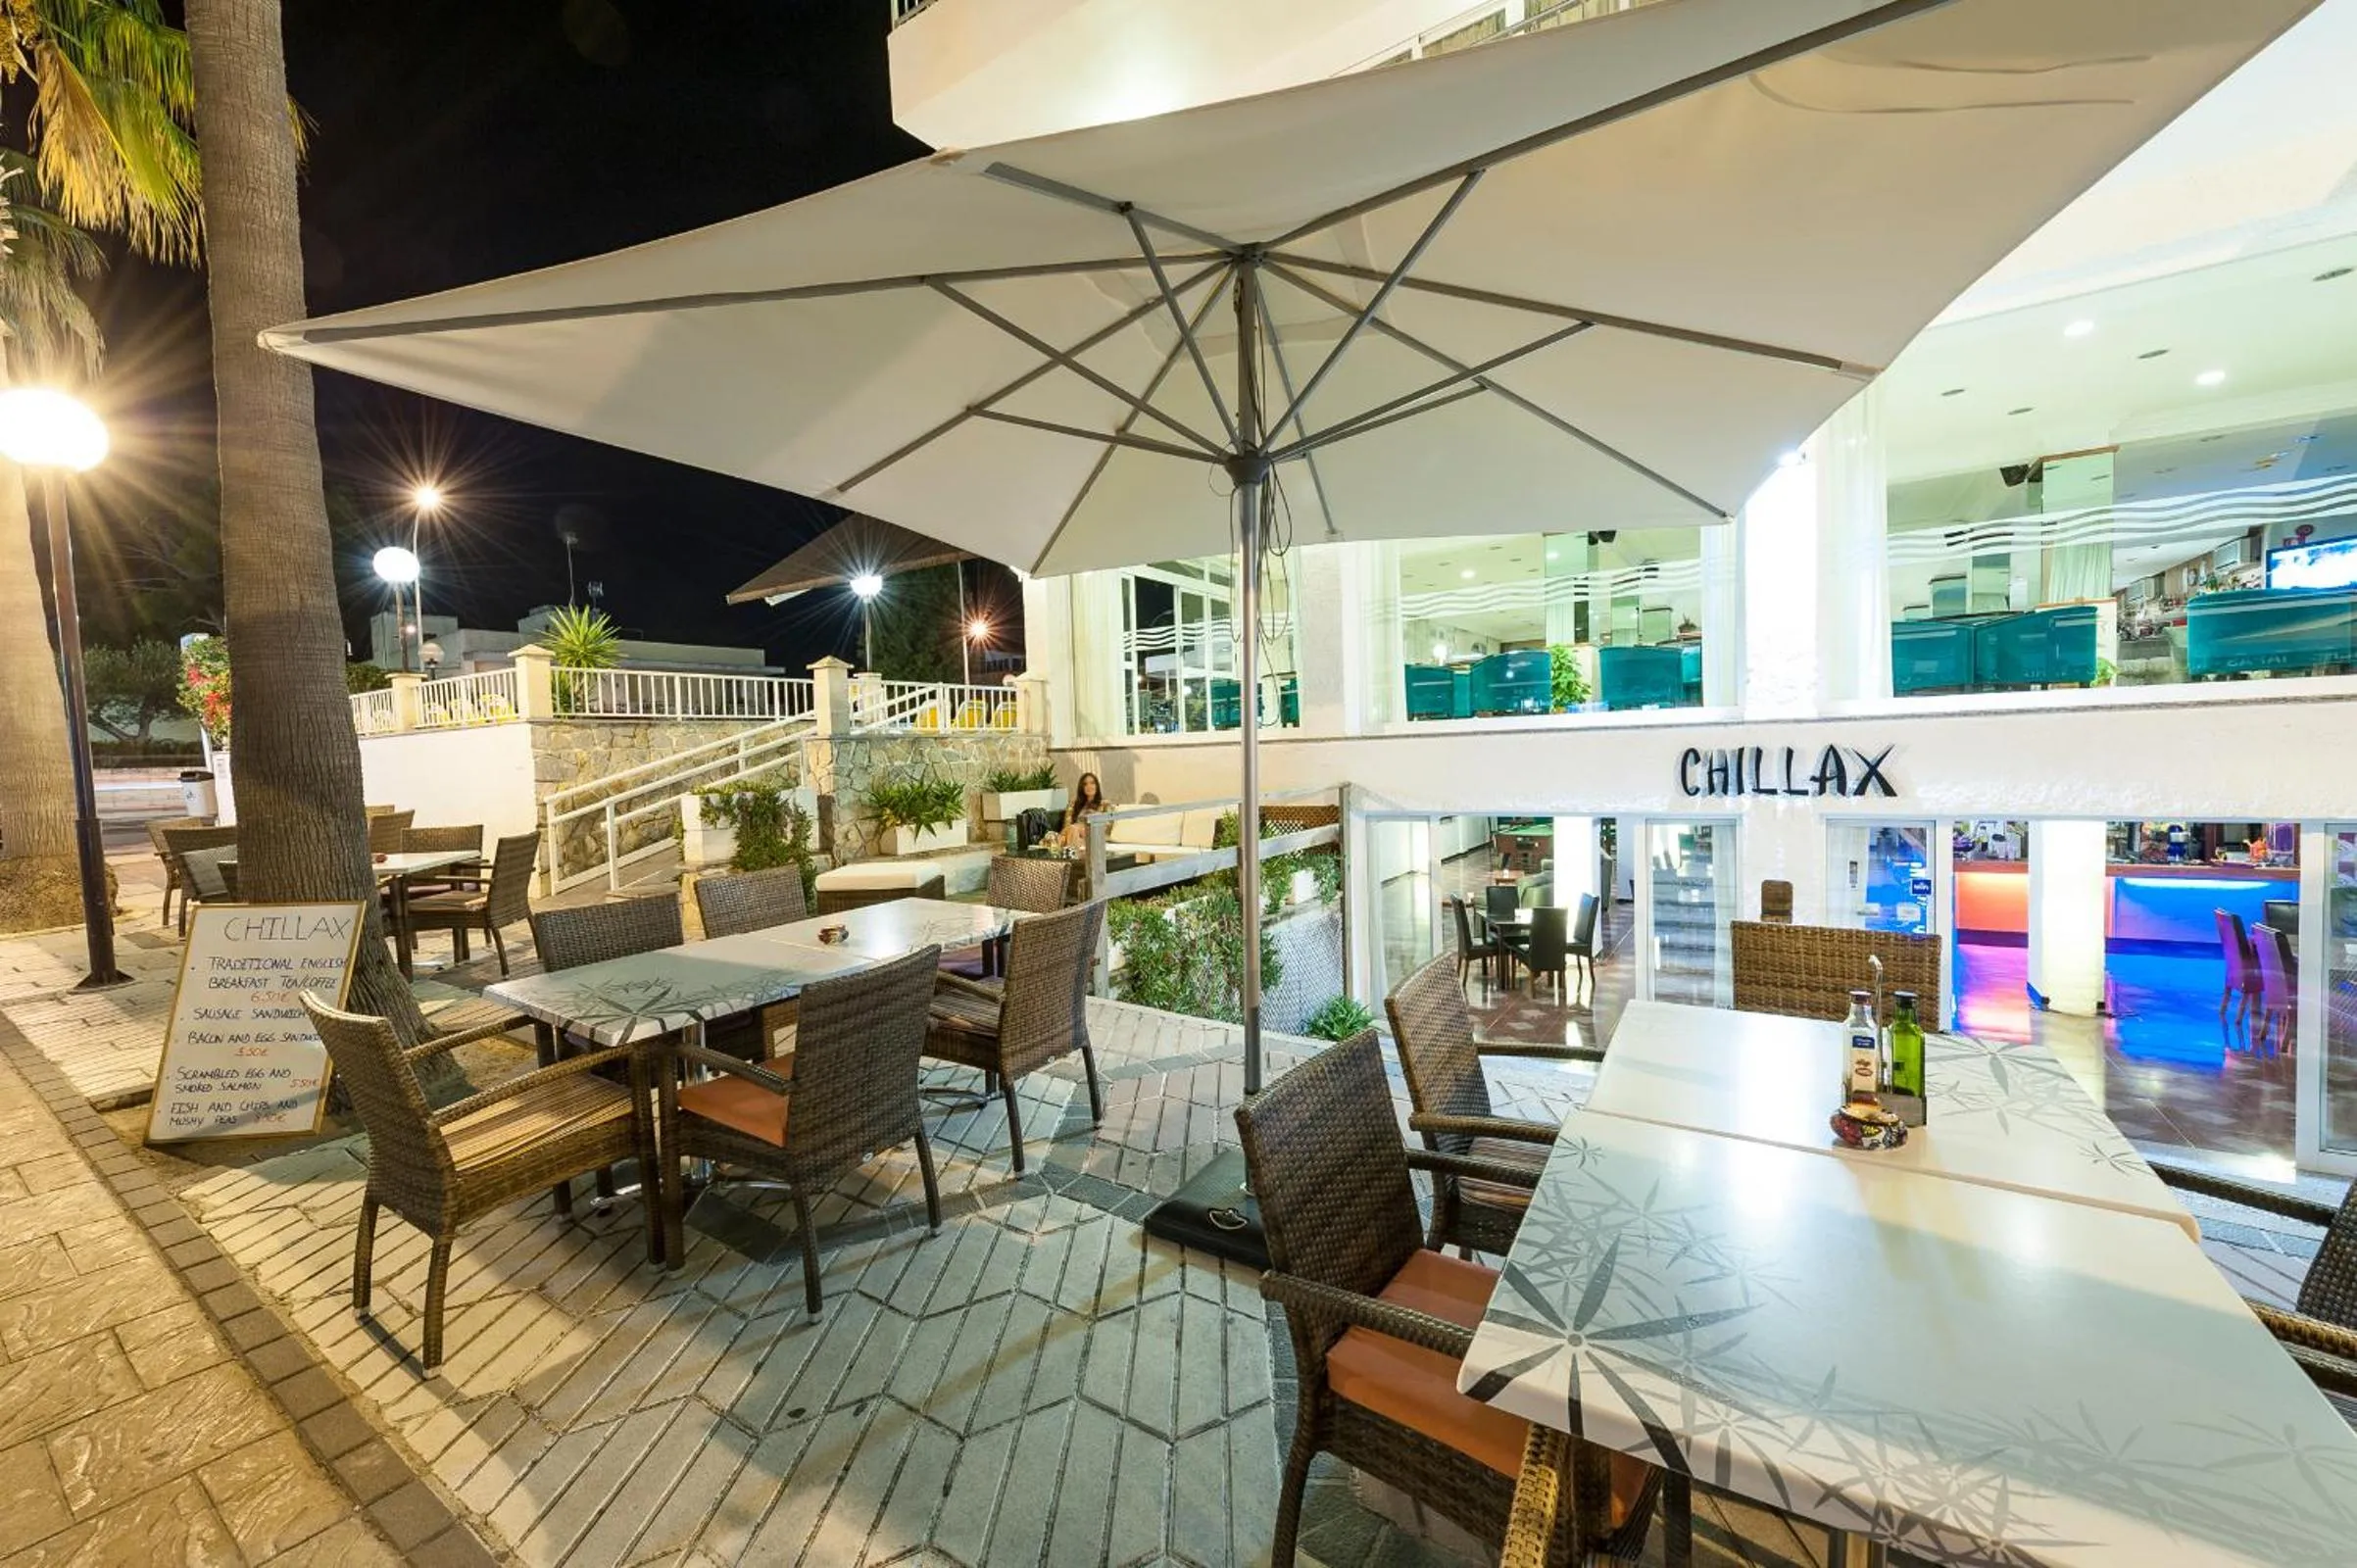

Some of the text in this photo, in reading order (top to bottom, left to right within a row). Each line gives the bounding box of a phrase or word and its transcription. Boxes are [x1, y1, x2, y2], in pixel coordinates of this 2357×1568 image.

[1678, 742, 1898, 798] CHILLAX
[222, 914, 353, 942] CHILLAX
[298, 956, 347, 970] ENGLISH
[208, 976, 271, 990] BREAKFAST
[193, 1006, 243, 1020] SAUSAGE
[187, 1030, 223, 1045] BACON
[226, 1032, 251, 1044] AND
[254, 1031, 276, 1043] EGG
[176, 1065, 292, 1080] SCRAMBLED EGG AND
[174, 1082, 213, 1095] SMOKED
[218, 1080, 263, 1092] SALMON
[170, 1101, 201, 1115] FISH
[207, 1101, 234, 1113] AND
[276, 1099, 299, 1110] AND
